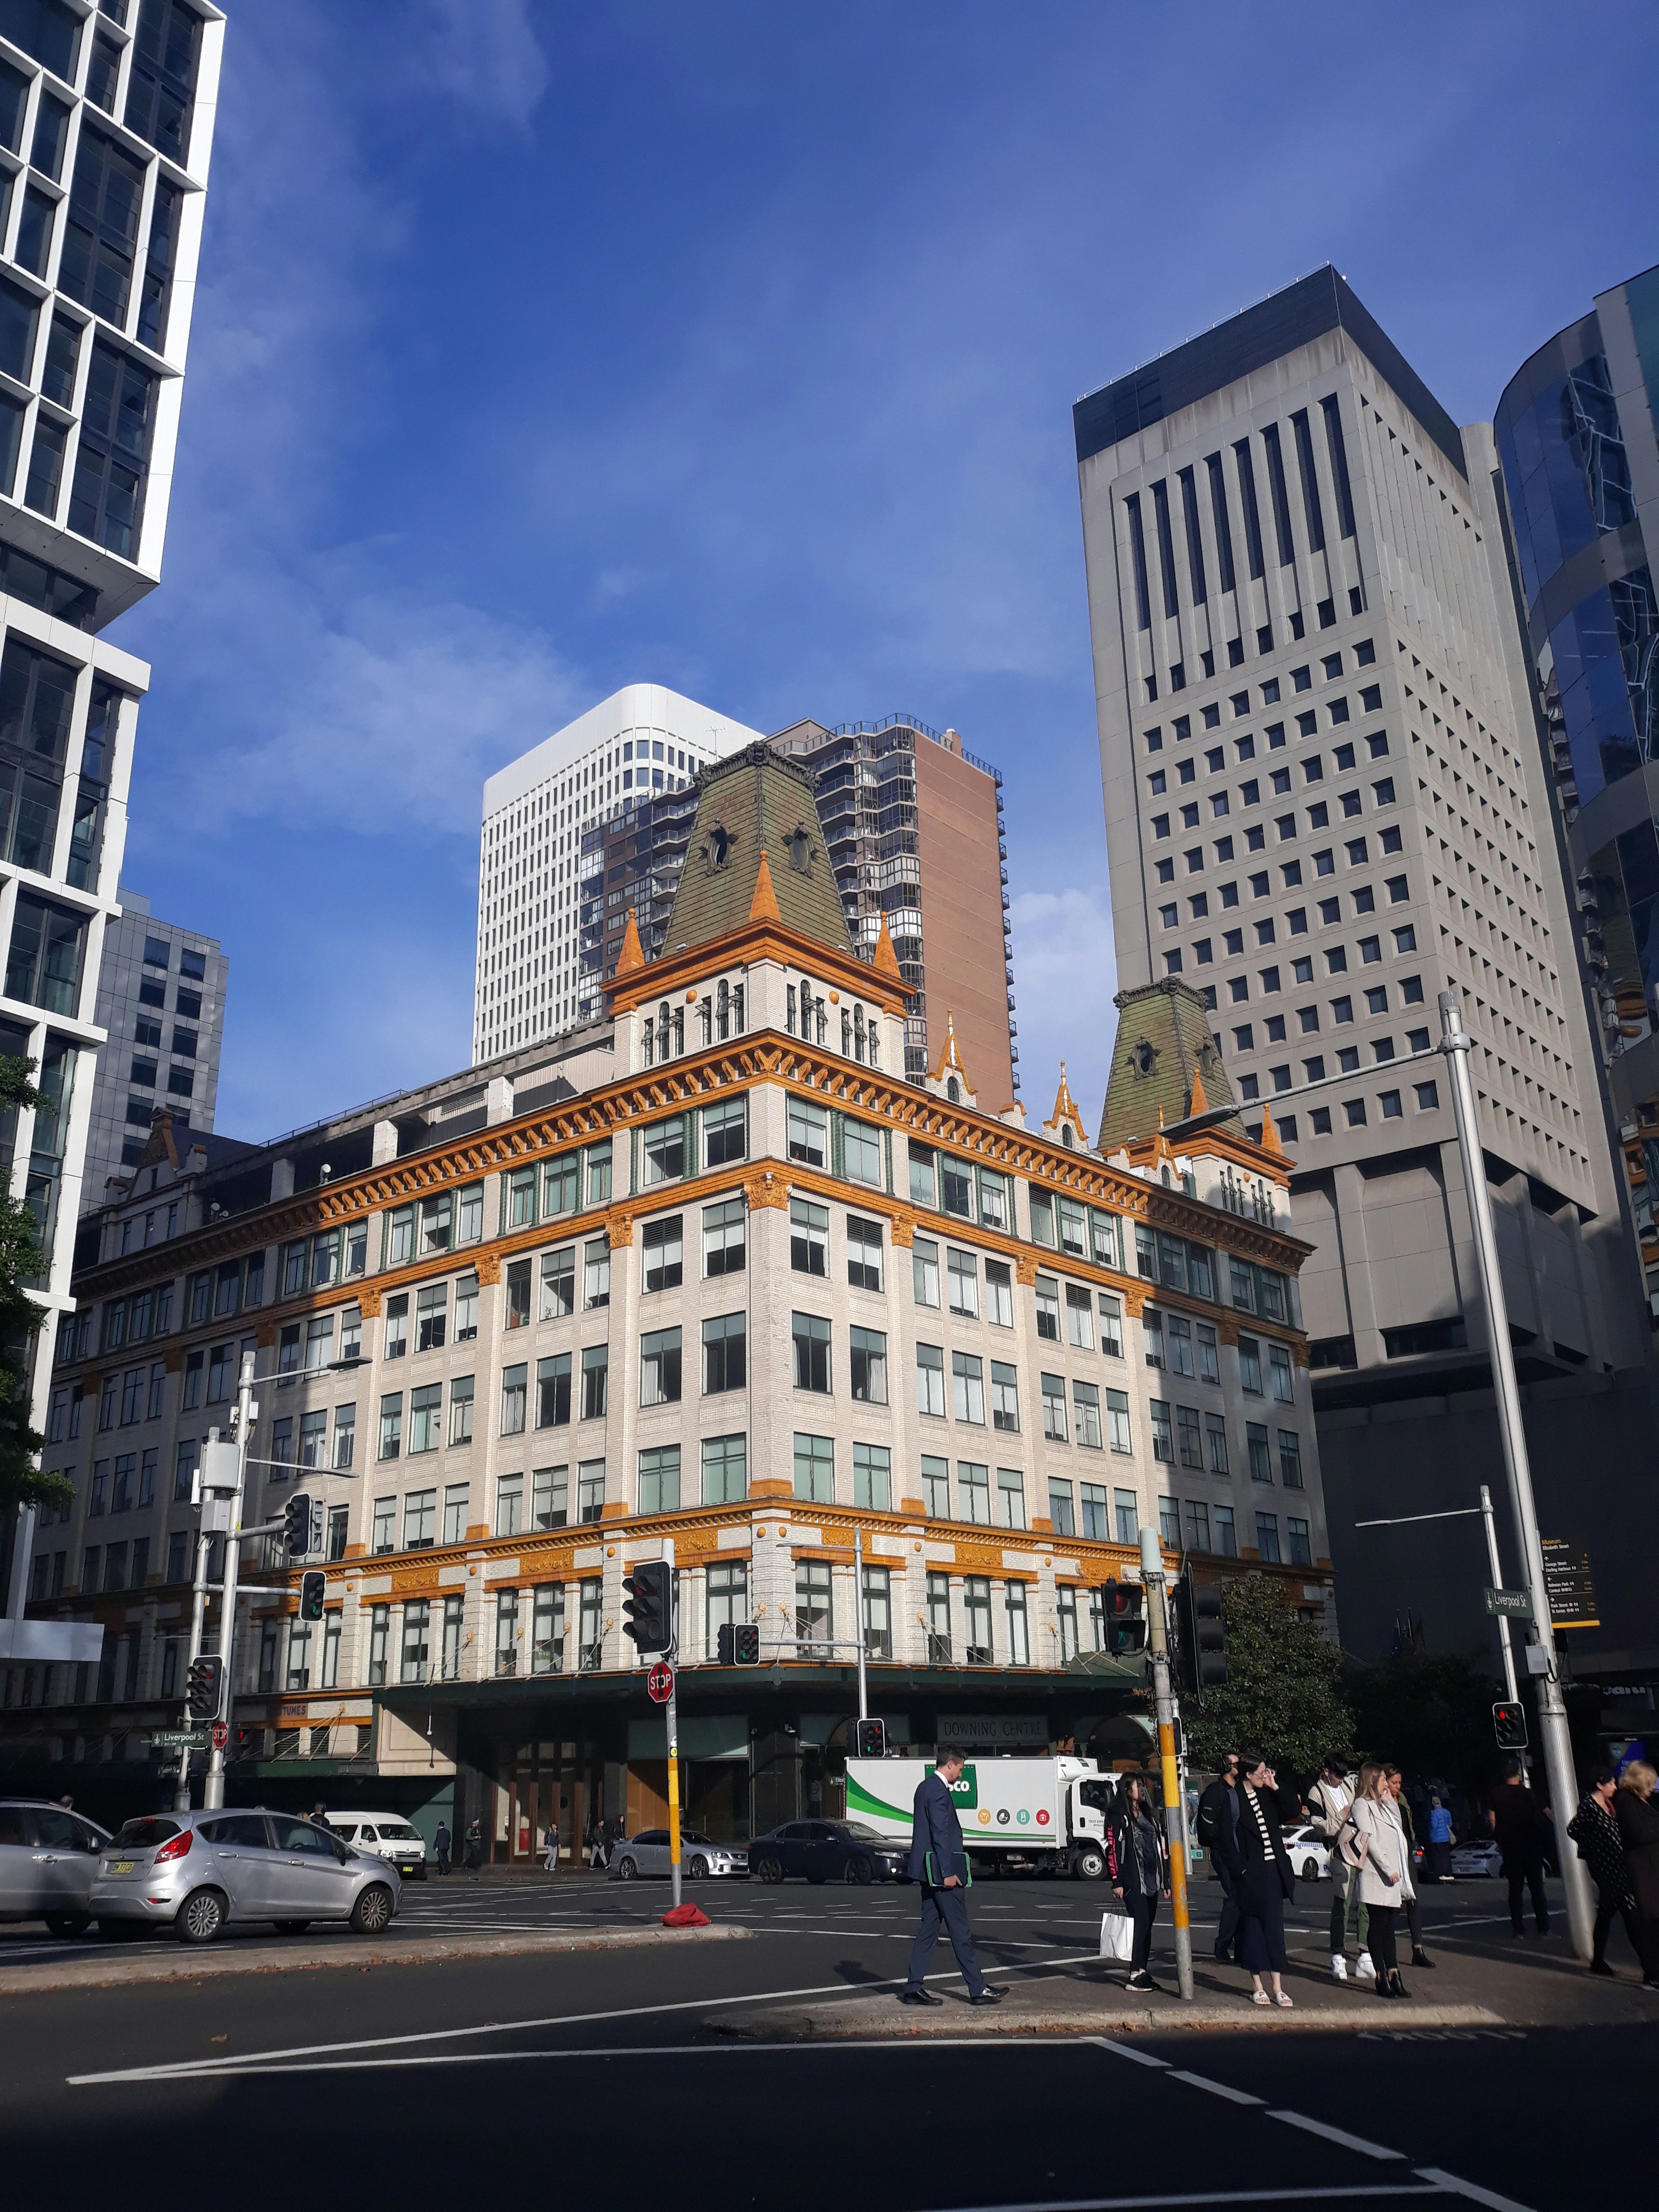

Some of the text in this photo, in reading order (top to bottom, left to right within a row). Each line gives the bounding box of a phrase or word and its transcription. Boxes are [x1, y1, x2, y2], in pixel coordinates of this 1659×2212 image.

[1494, 1591, 1527, 1609] Liverpool St
[650, 1673, 671, 1690] STOP
[214, 1729, 227, 1739] STOP
[945, 1721, 1042, 1736] DOWNING CENTRE
[164, 1732, 205, 1743] Liverpool St
